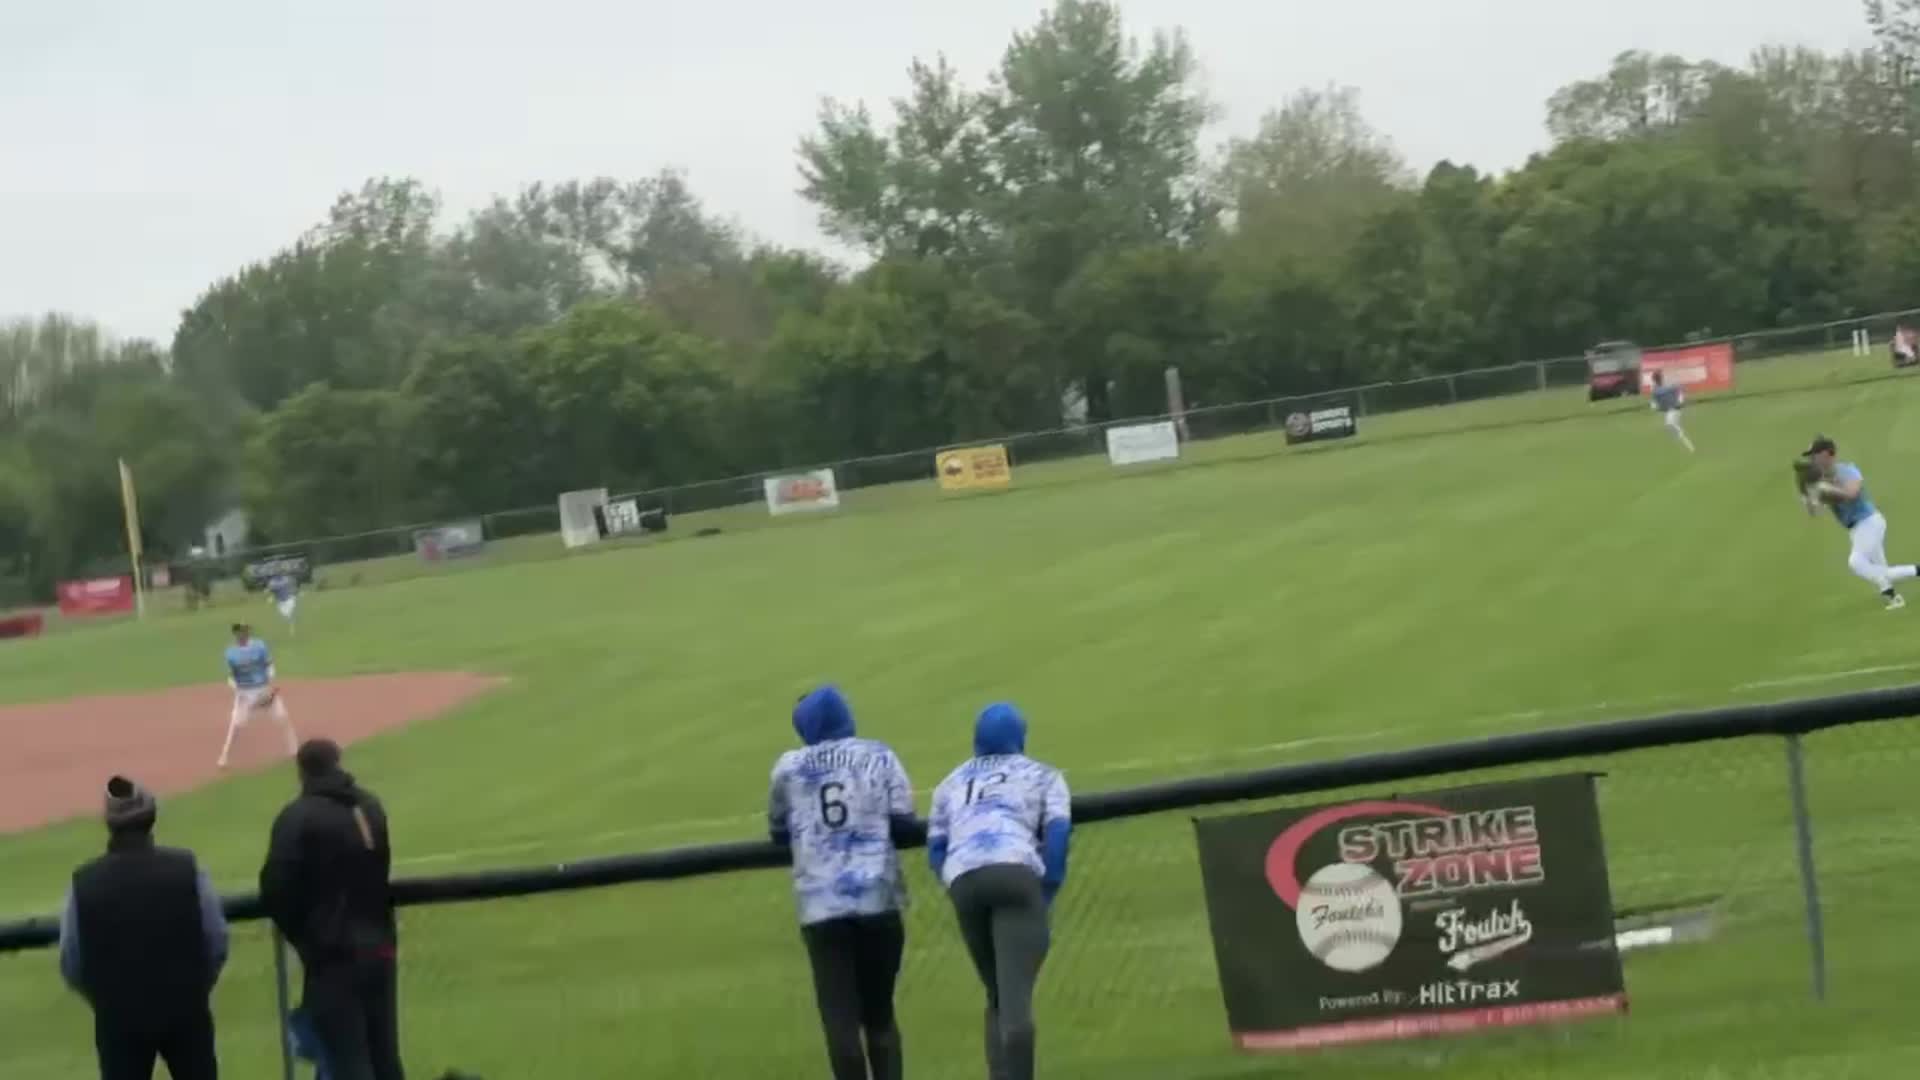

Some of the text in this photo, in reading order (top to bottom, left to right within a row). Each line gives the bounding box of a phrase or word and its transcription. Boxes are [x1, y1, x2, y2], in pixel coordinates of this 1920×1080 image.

[820, 781, 848, 828] 6
[965, 771, 1007, 805] 12
[1338, 806, 1537, 864] STRIKE
[1396, 843, 1545, 898] ZONE
[1319, 991, 1379, 1010] Powered
[1418, 979, 1520, 1005] HitTrax
